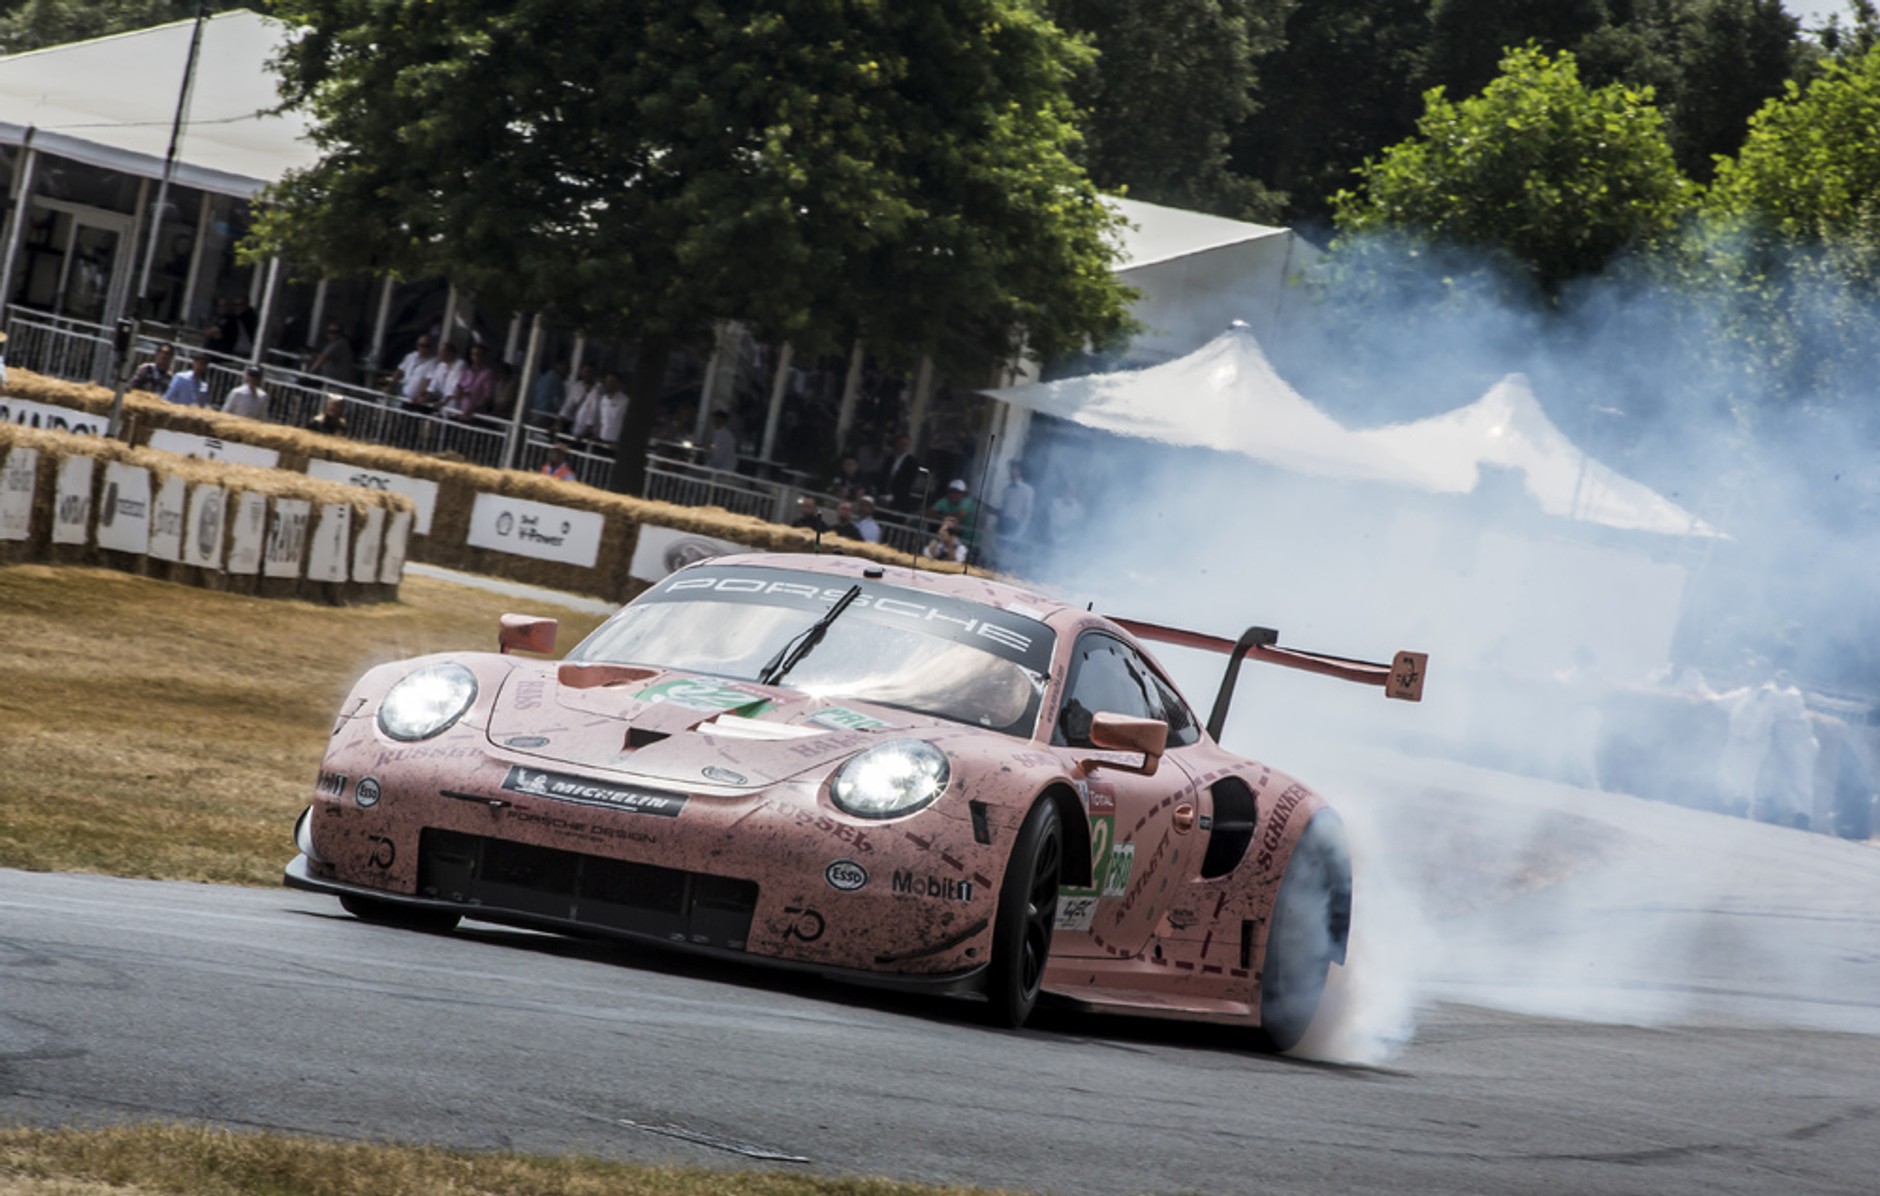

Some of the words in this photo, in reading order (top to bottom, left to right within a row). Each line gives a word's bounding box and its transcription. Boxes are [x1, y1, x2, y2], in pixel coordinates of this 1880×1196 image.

[665, 577, 1032, 653] PORSCHE
[551, 781, 669, 809] MICHELIN
[506, 810, 586, 831] PORSCHE
[590, 824, 657, 844] DESIGN
[831, 866, 864, 885] Esso
